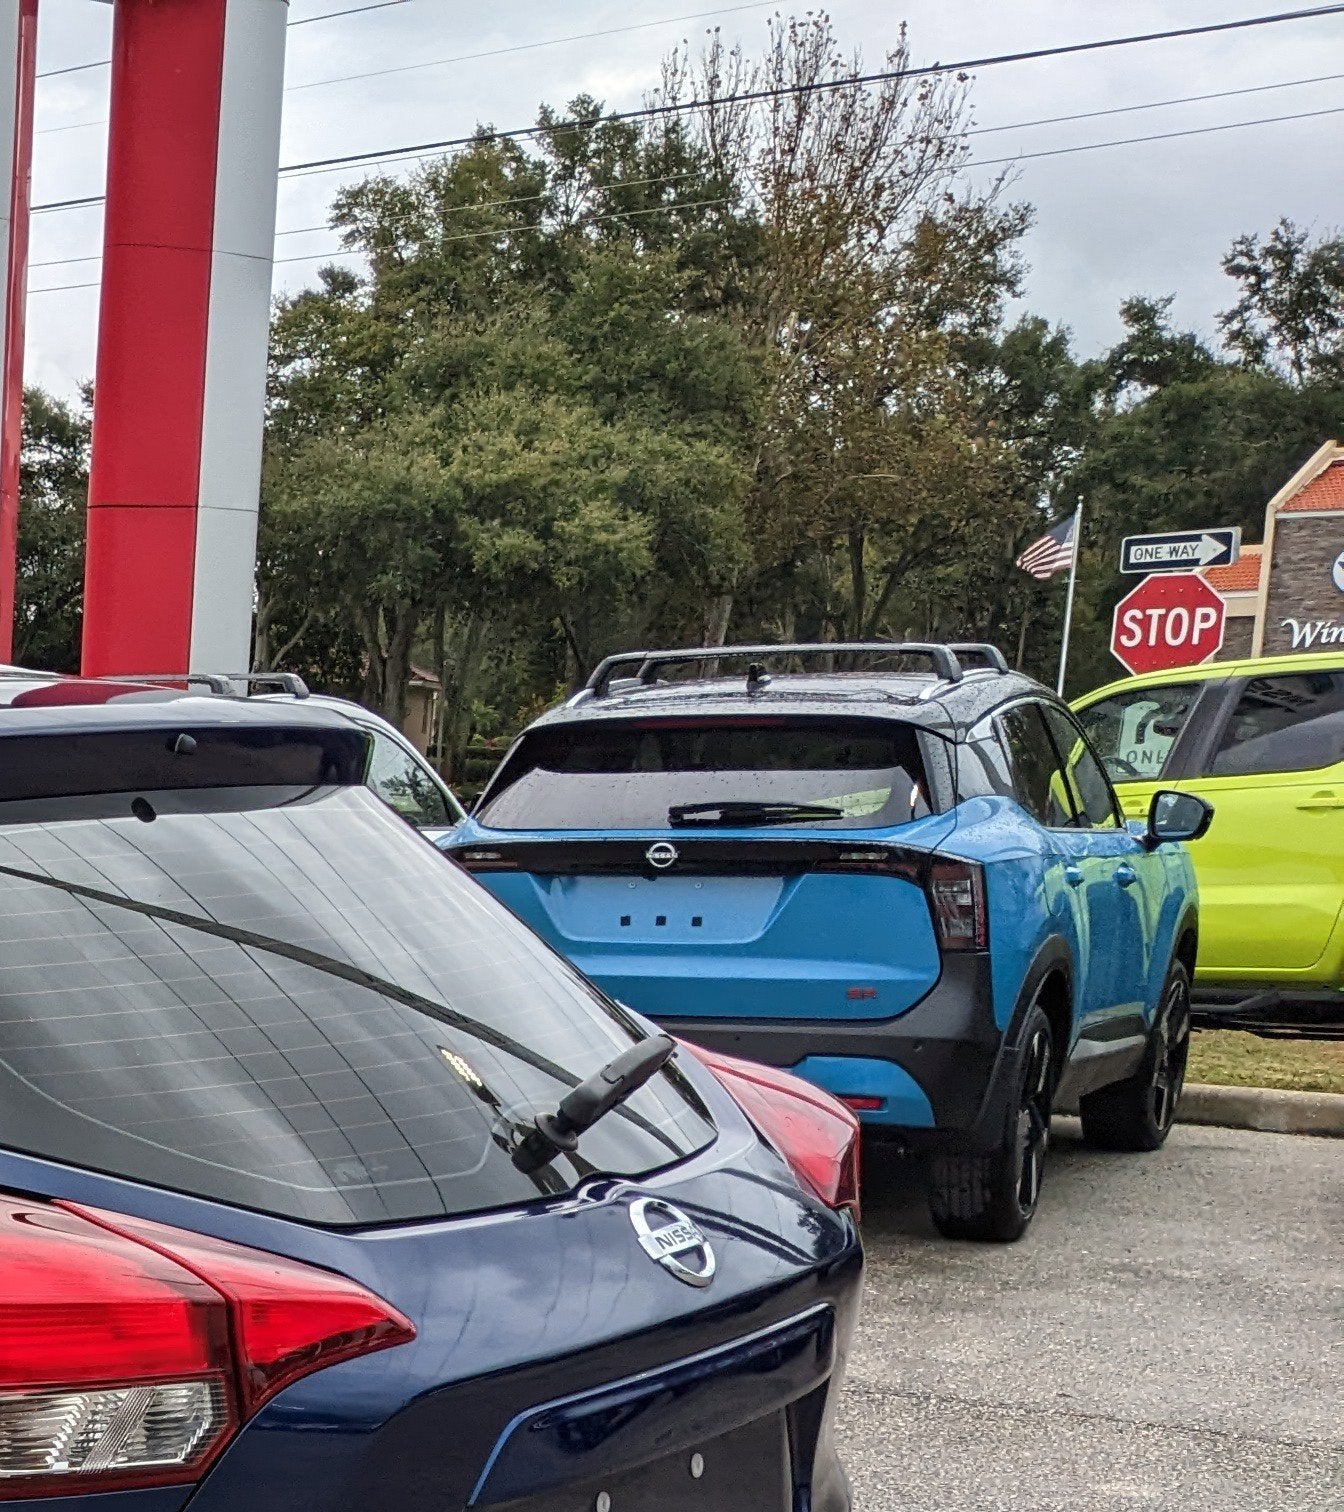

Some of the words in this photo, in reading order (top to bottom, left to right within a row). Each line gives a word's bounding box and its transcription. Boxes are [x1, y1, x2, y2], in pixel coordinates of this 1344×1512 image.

[1134, 547, 1162, 560] ONE
[1168, 544, 1199, 558] WAY
[1120, 607, 1217, 647] STOP
